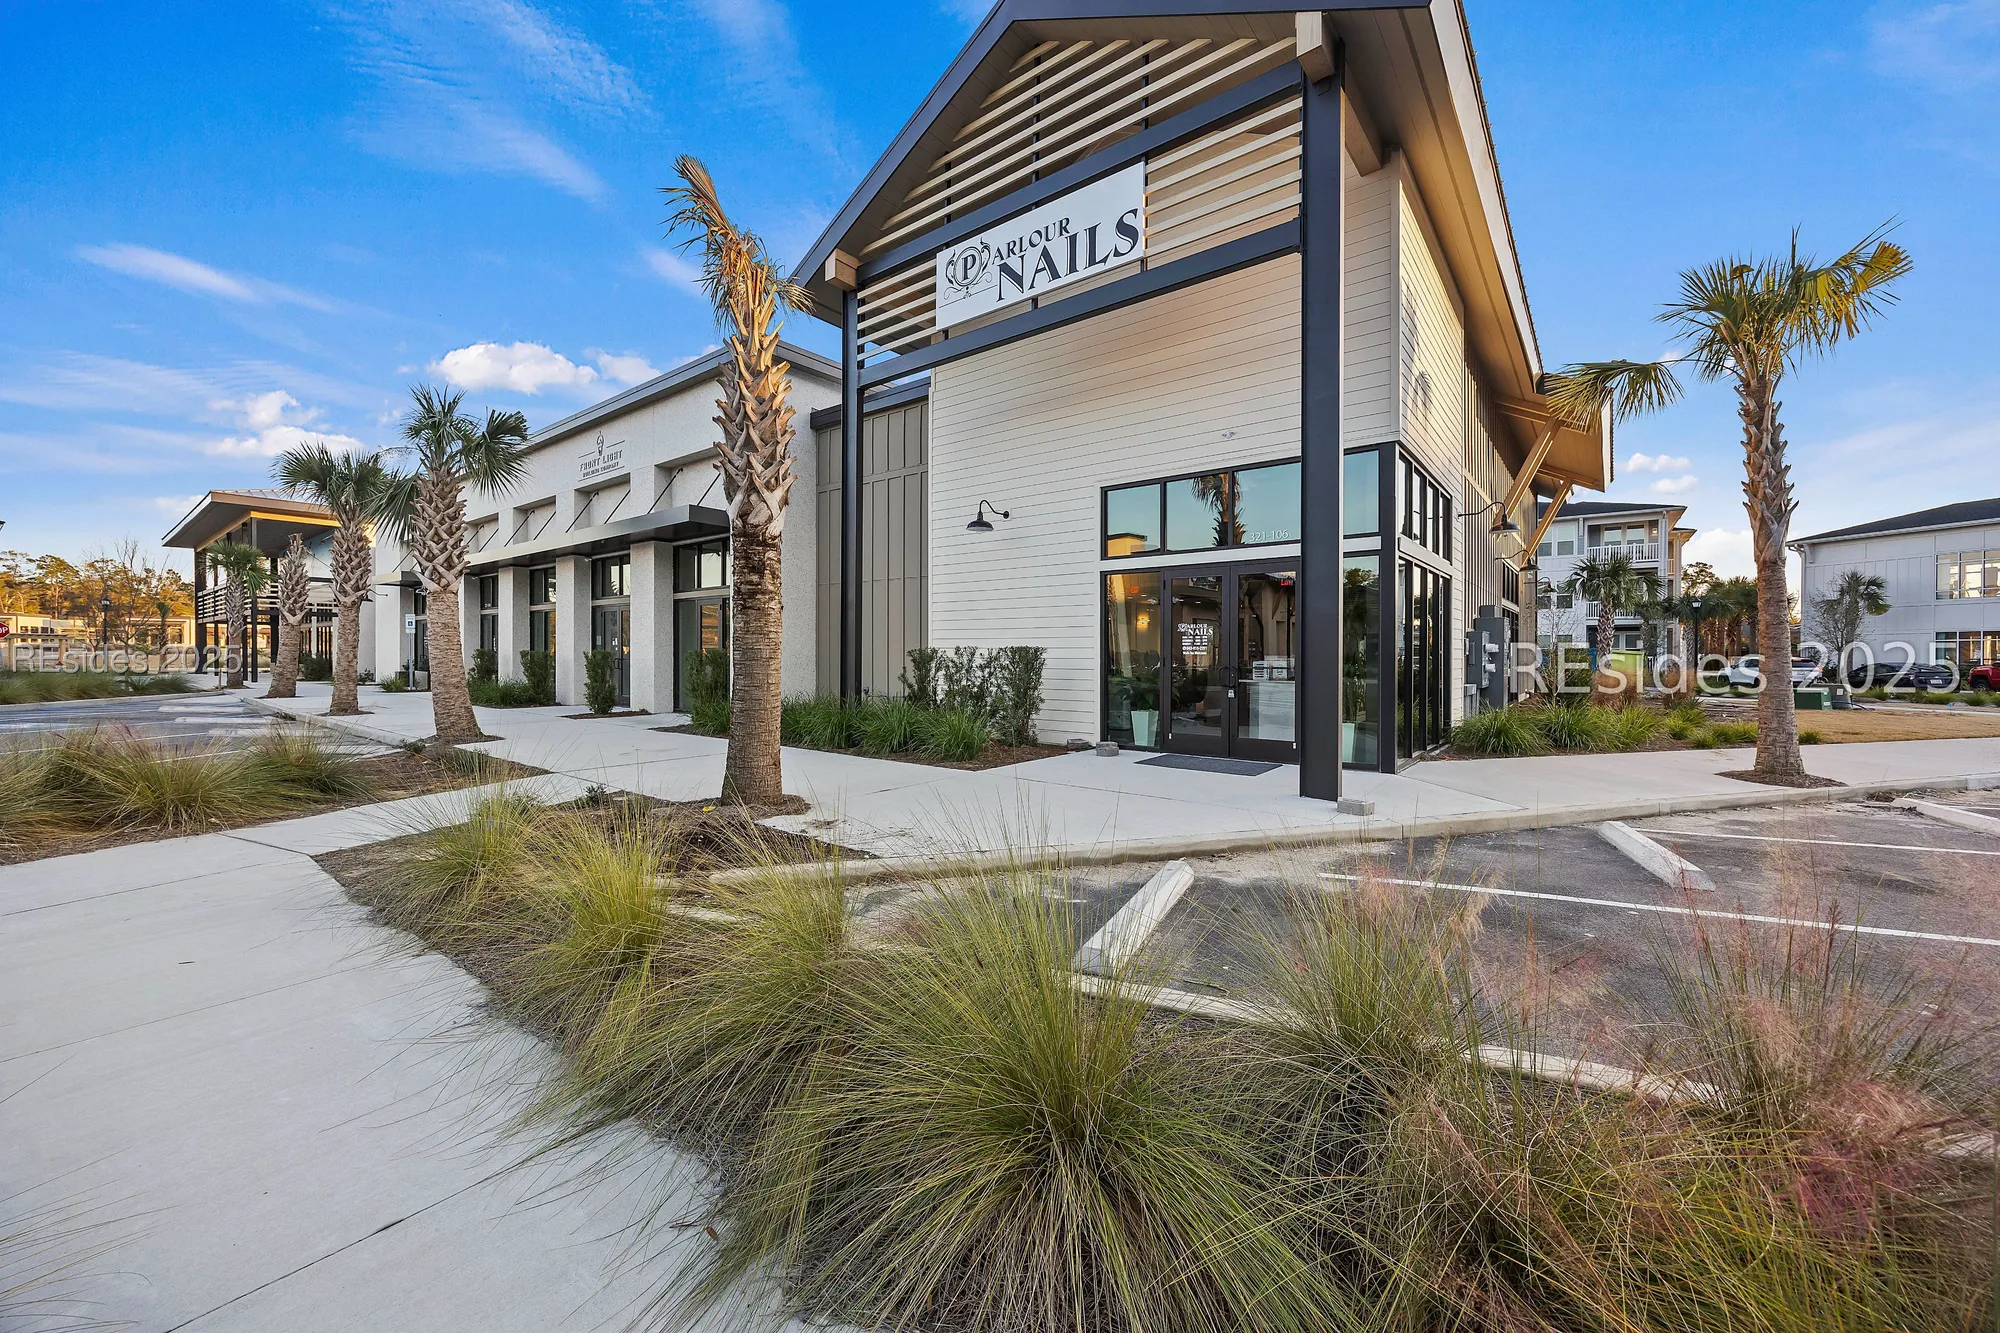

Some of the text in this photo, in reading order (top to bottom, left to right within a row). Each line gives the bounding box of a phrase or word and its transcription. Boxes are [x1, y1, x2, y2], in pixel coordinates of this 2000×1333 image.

[996, 208, 1139, 302] NAILS
[603, 450, 623, 464] LIGHT
[1188, 627, 1213, 636] NAILS
